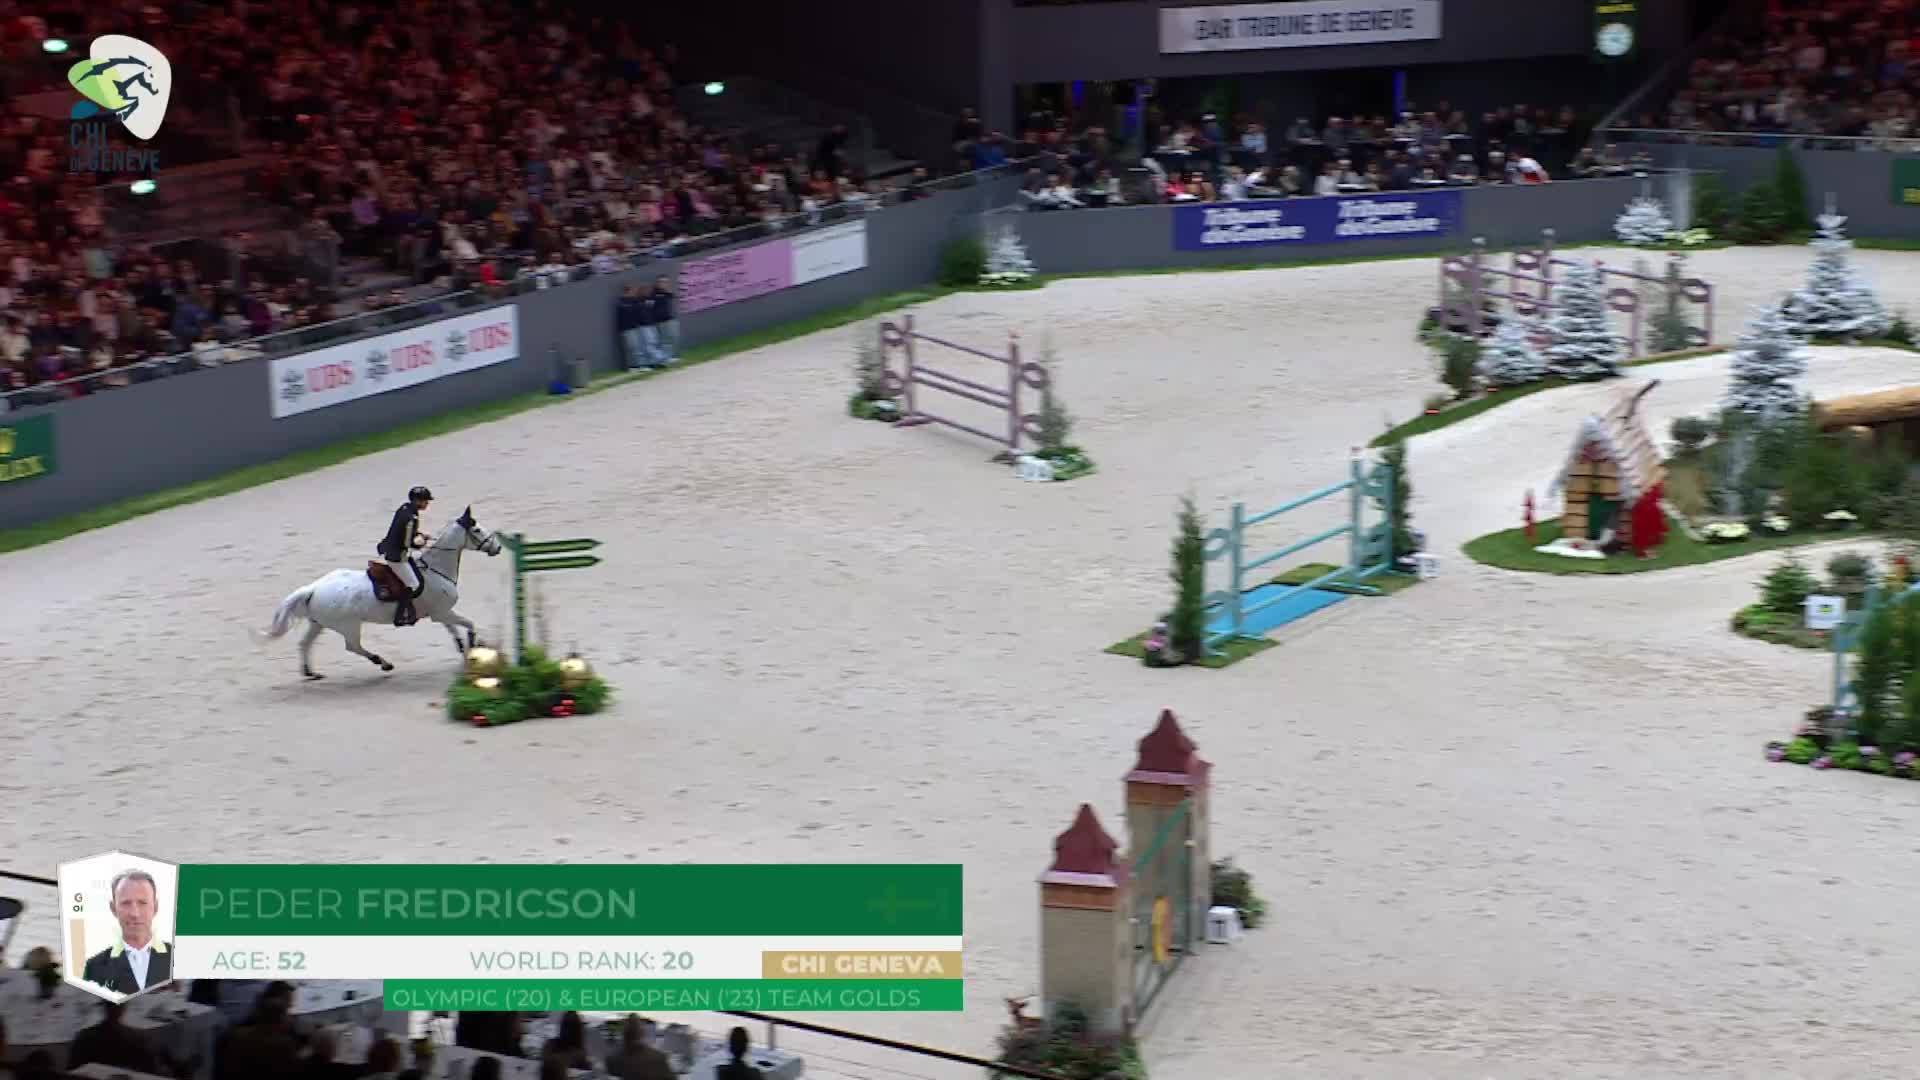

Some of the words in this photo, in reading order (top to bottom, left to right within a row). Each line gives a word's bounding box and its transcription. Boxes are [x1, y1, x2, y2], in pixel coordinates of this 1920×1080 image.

[1195, 17, 1231, 40] BAR
[1236, 14, 1313, 37] TRIBUNE
[1318, 12, 1341, 33] DE
[467, 321, 513, 353] UBS
[390, 340, 435, 372] UBS
[305, 360, 354, 393] UBS
